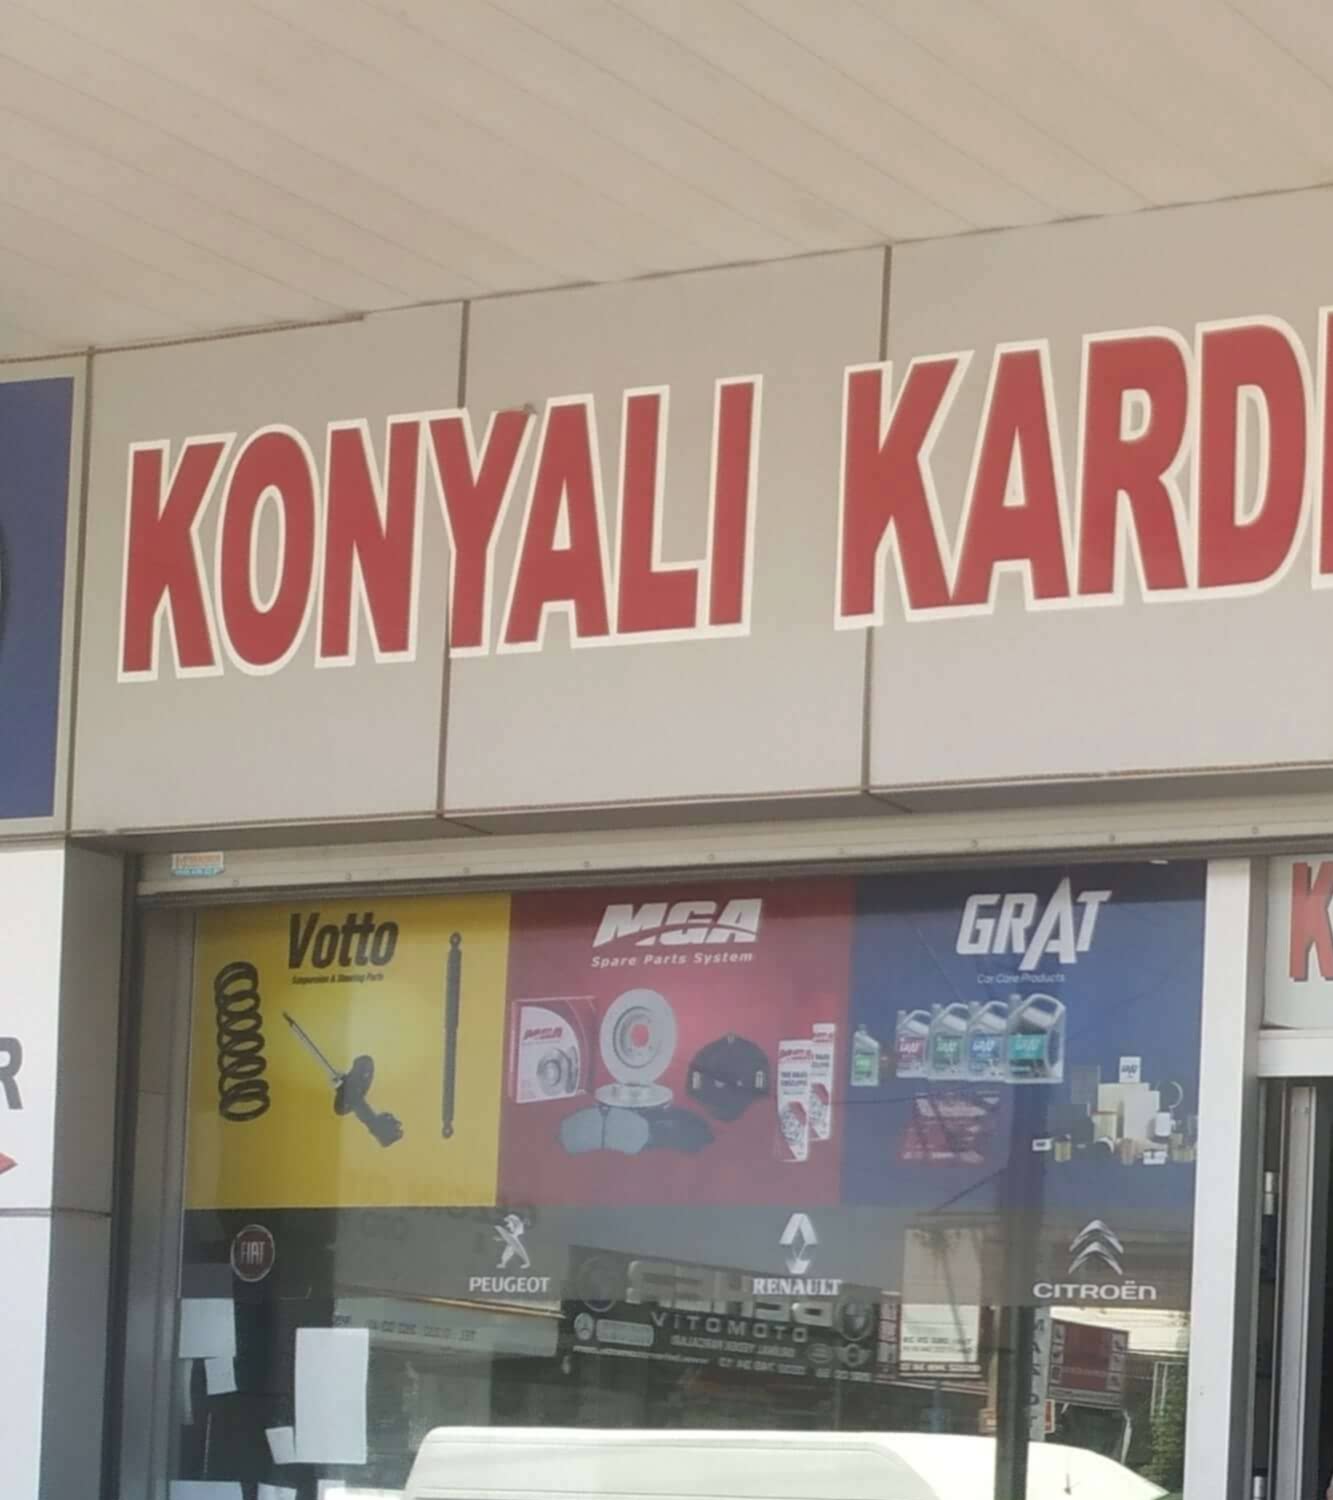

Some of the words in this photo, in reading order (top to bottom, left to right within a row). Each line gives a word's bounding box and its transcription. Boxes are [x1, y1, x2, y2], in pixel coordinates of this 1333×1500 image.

[117, 375, 763, 682] KONYALI
[288, 911, 400, 969] Votto
[592, 898, 763, 948] MGA
[955, 877, 1113, 970] GRAT
[591, 956, 637, 969] Spare
[643, 954, 687, 966] Parts
[693, 951, 753, 967] System
[0, 1037, 24, 1110] R
[240, 1240, 266, 1264] FIAT
[469, 1276, 550, 1294] PEUGEOT
[752, 1278, 843, 1297] RENAULT
